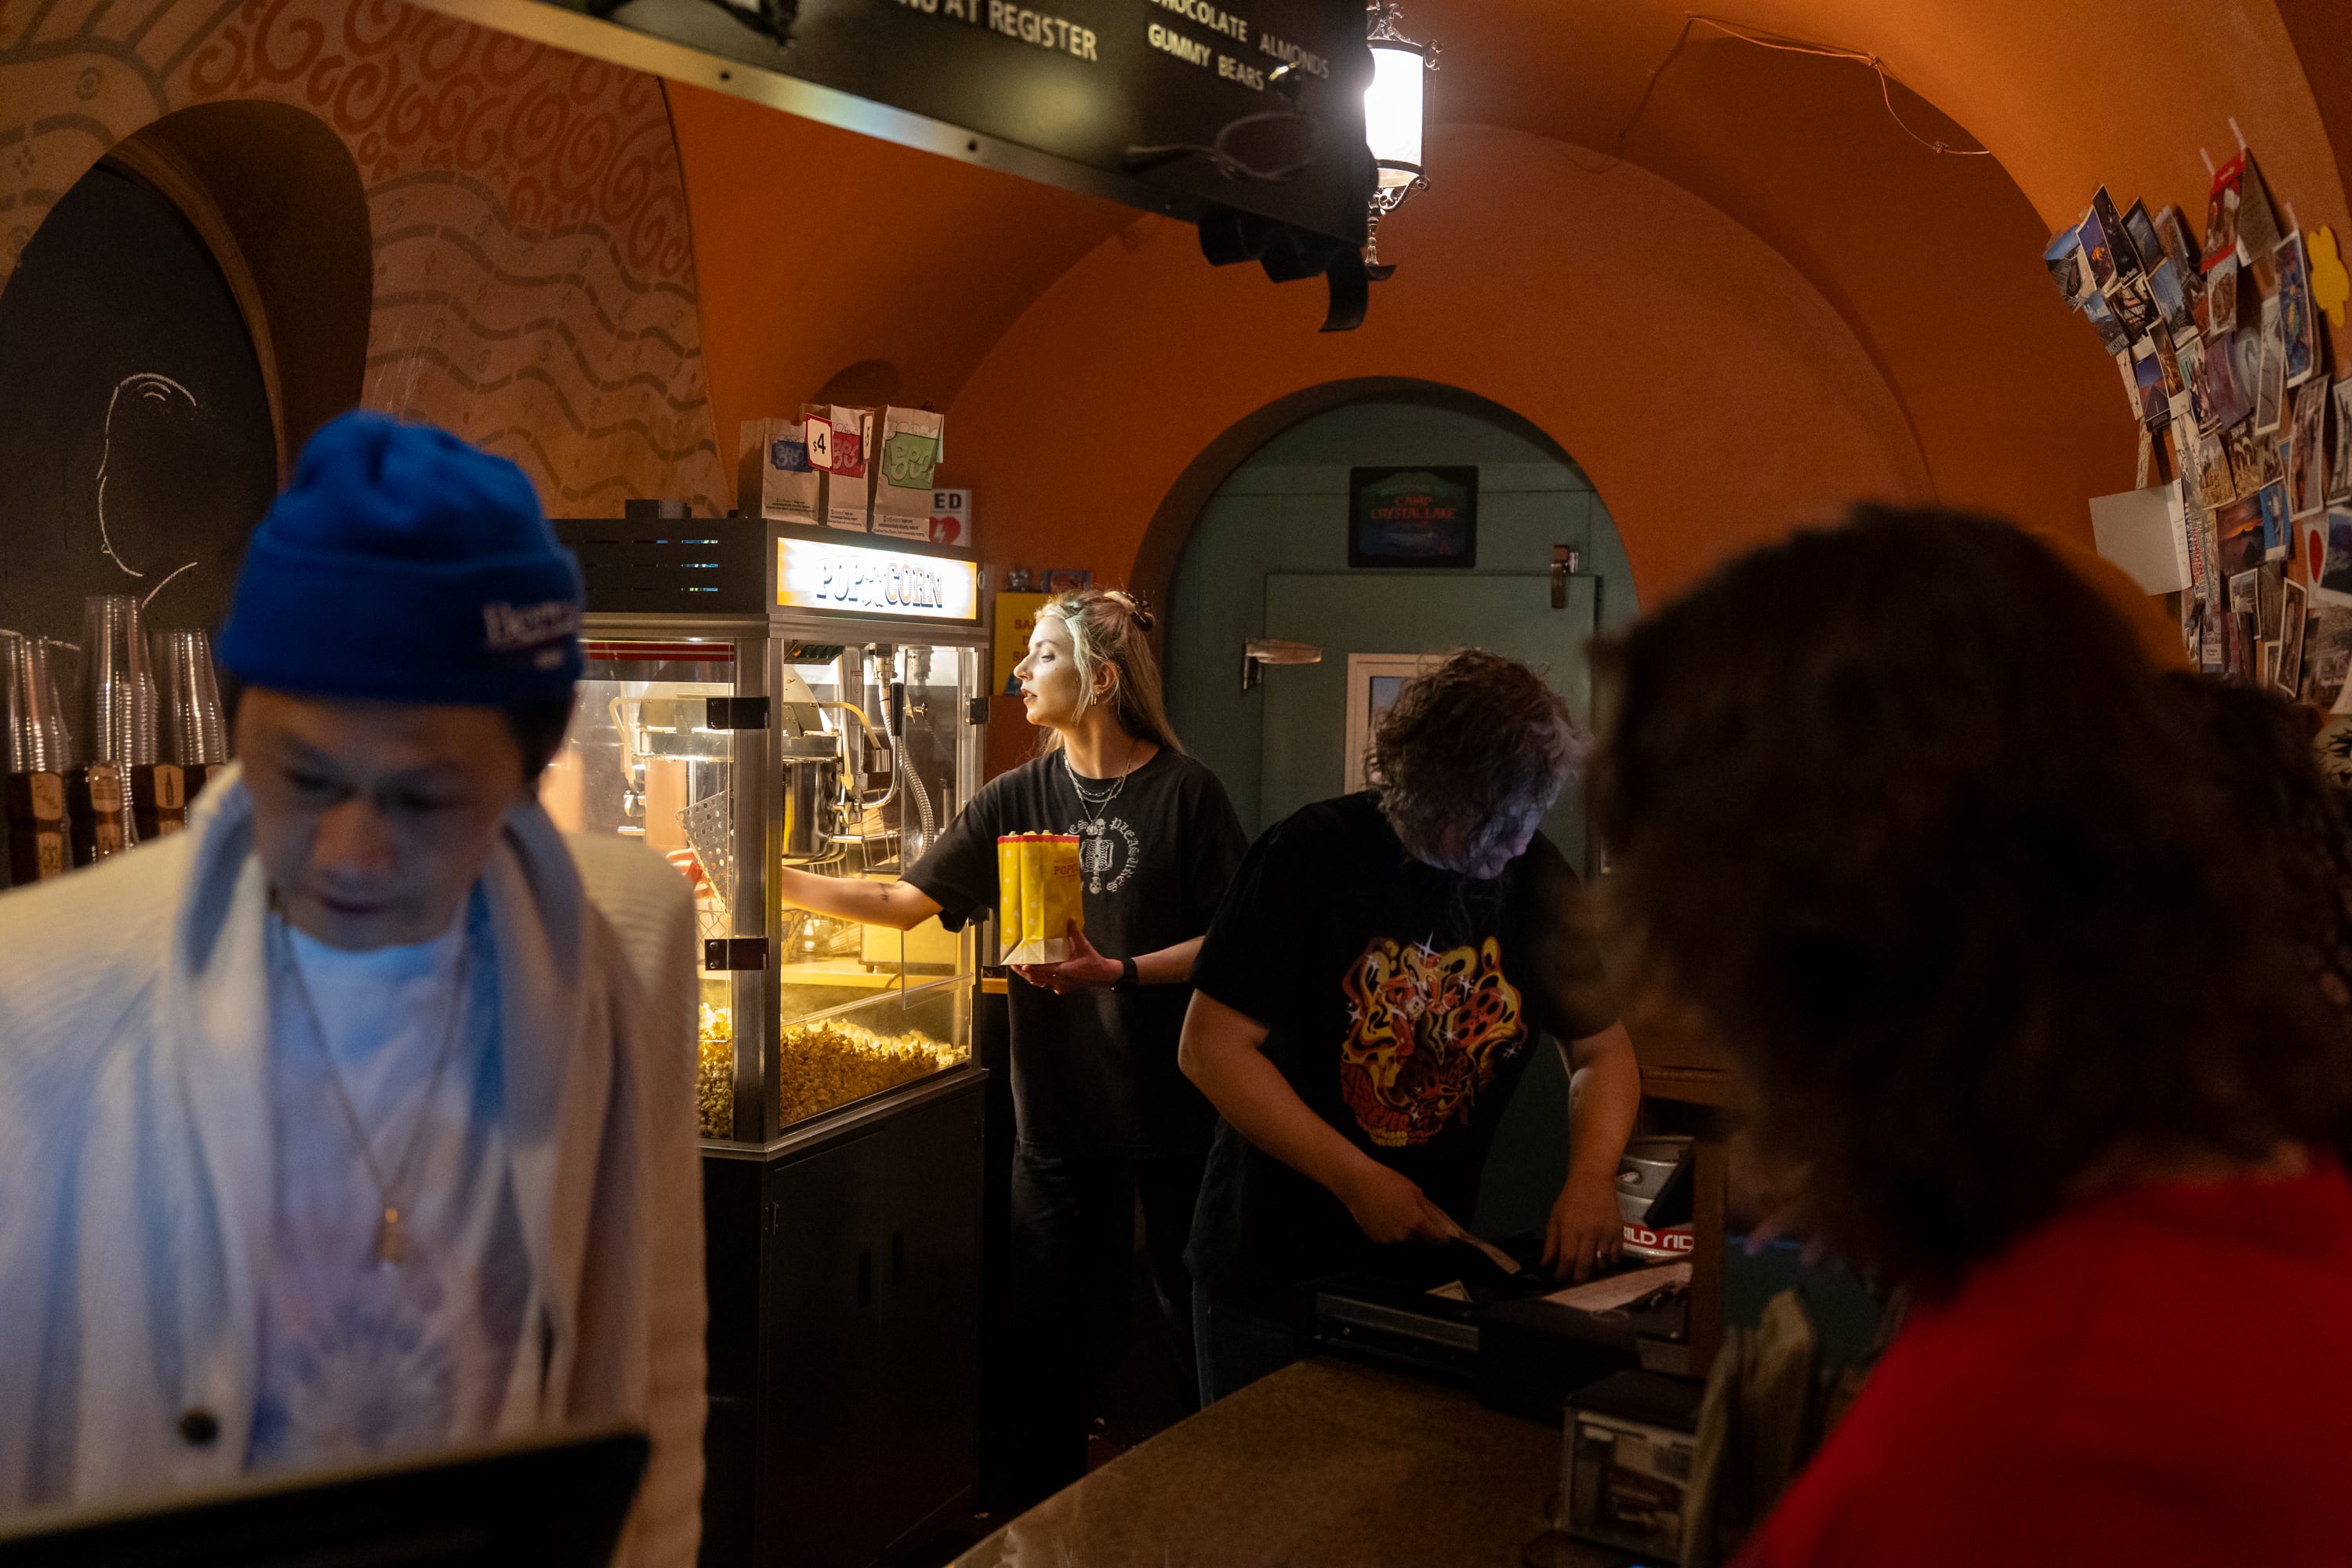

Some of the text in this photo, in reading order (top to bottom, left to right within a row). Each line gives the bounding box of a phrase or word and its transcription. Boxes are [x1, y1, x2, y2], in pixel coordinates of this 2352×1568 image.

[988, 0, 1098, 63] REGISTER
[1152, 0, 1330, 79] OCOLATE ALMONDS
[1148, 23, 1265, 92] GUMMY BEARS
[812, 433, 826, 455] $4
[934, 492, 962, 510] ED
[1370, 506, 1457, 521] CRYSTAL LAKE
[1624, 1225, 1658, 1246] ILD
